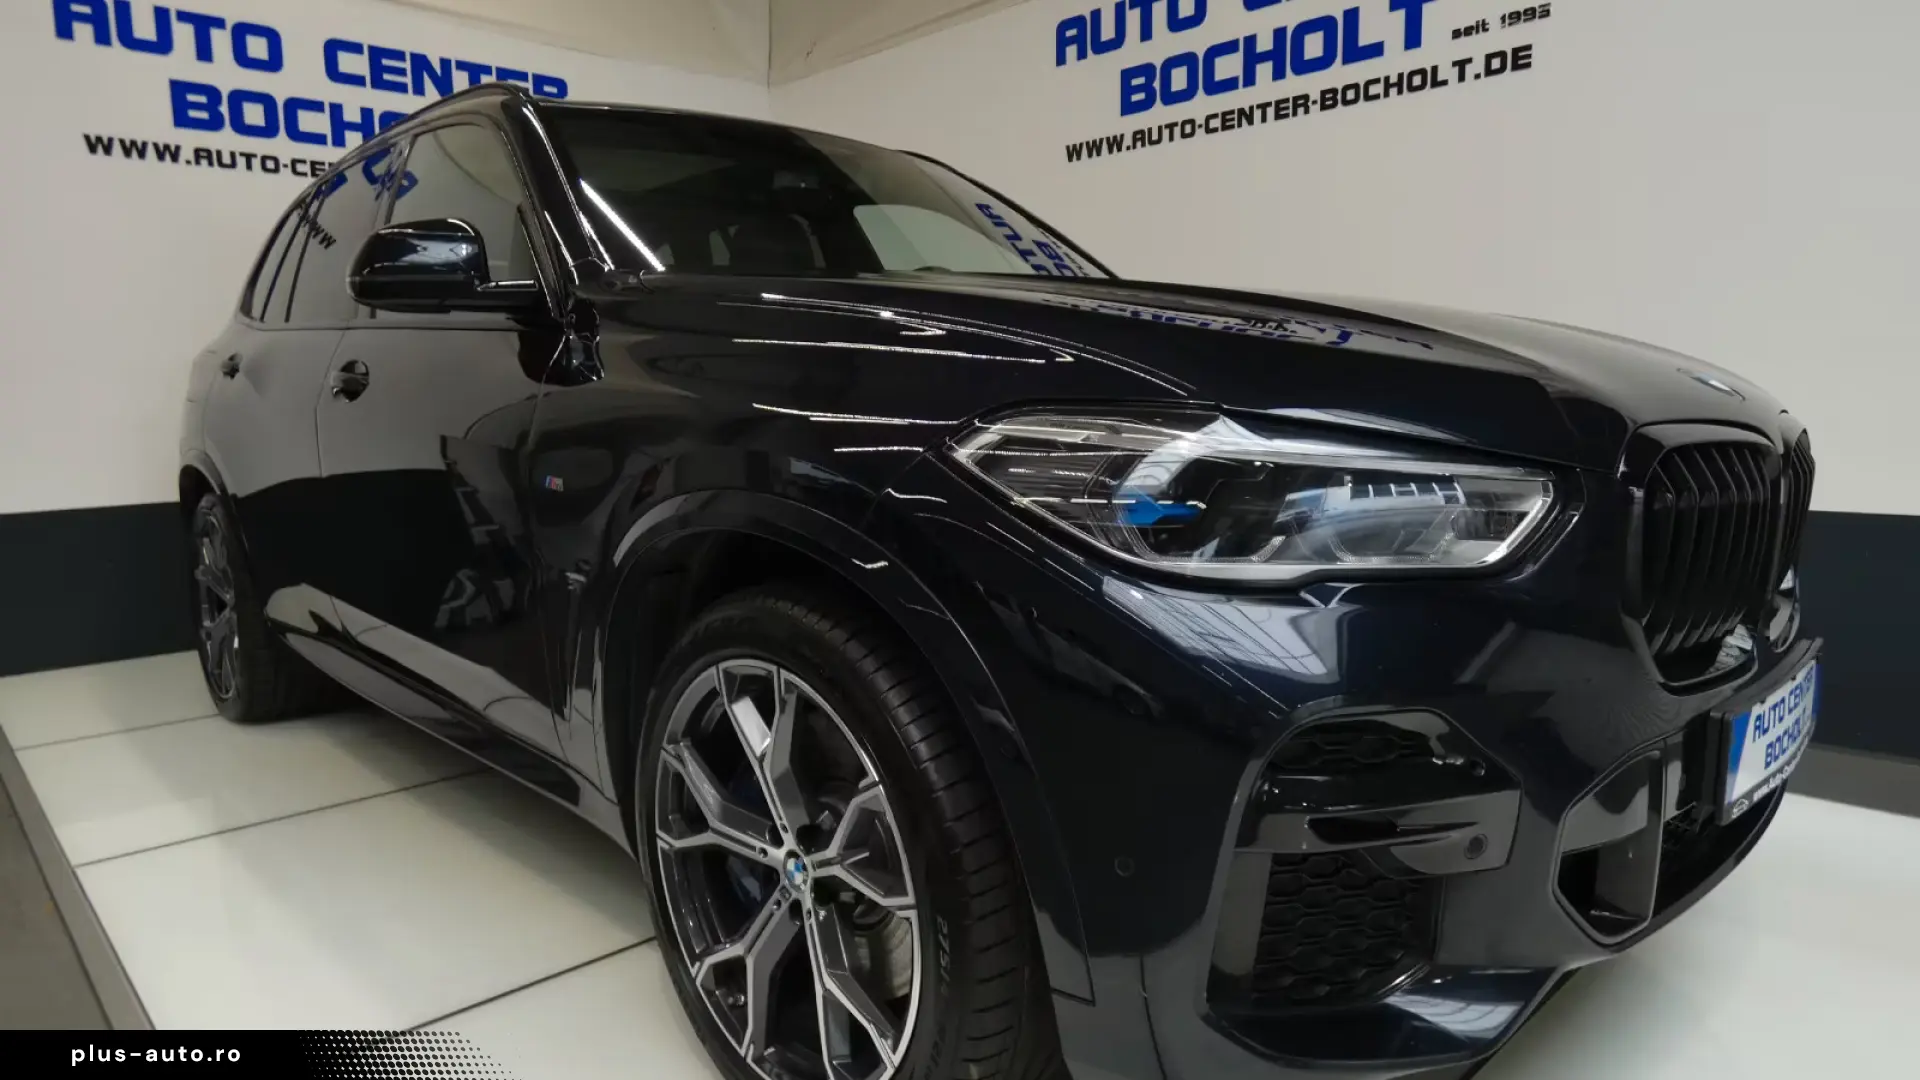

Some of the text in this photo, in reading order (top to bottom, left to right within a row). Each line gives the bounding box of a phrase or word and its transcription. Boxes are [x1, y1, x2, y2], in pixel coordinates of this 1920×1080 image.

[52, 0, 284, 73] AUTO
[1120, 0, 1438, 117] BOCHOLT
[1451, 18, 1490, 41] seit
[1065, 43, 1533, 163] WWW.AUTO-CENTER-BOCHOLT.DE
[83, 133, 336, 179] WWW.AUTO-CE
[1752, 696, 1786, 744] AUTO
